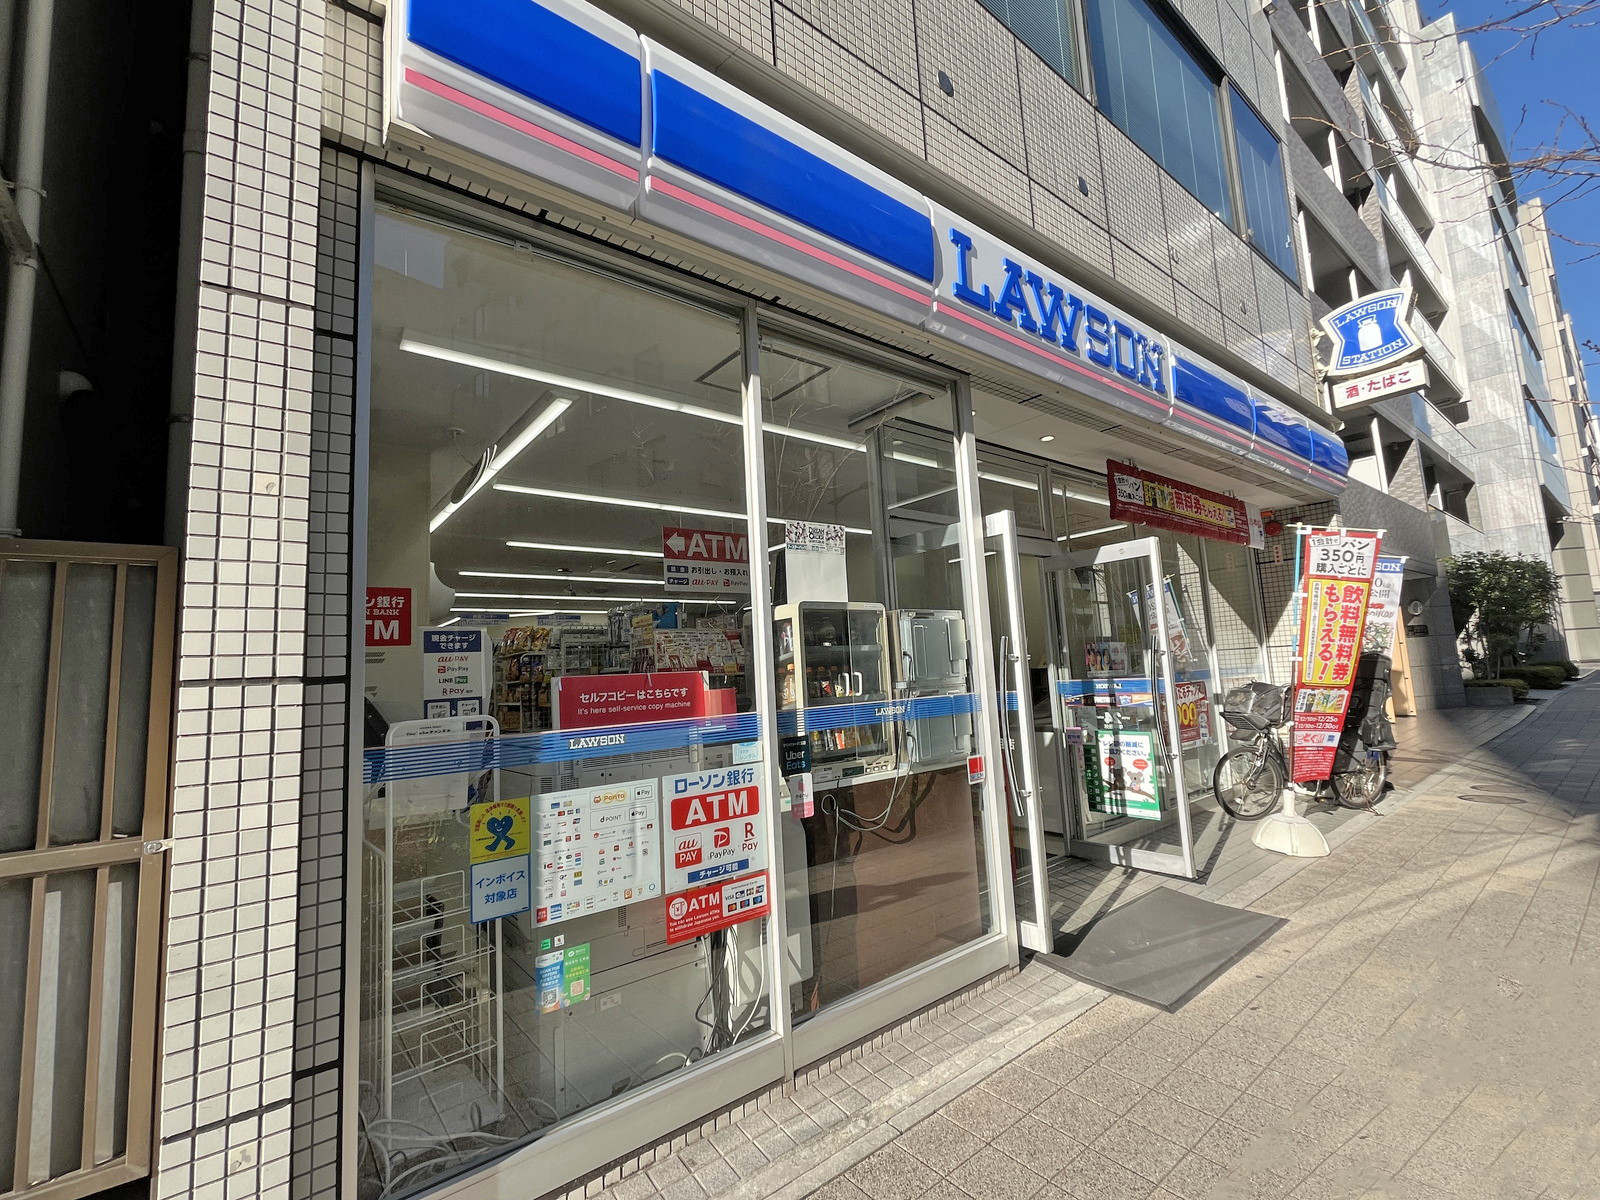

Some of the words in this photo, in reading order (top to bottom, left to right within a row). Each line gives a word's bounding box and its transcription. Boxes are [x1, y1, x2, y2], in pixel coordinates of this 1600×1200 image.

[949, 227, 1166, 394] LAWSON
[1335, 298, 1399, 328] LAWSON
[1341, 338, 1405, 366] STATION
[1345, 371, 1411, 399] 酒・たばこ
[687, 533, 748, 561] ATM
[1341, 539, 1369, 550] パン
[1320, 548, 1364, 563] 350円
[1316, 562, 1367, 576] 購入ごとに
[431, 633, 476, 643] 現金チャージ
[1332, 584, 1365, 681] 飲料無料券
[439, 642, 469, 650] できます
[579, 687, 689, 703] セルフコピーはこちらです
[577, 707, 589, 715] It's
[590, 706, 606, 714] here
[608, 704, 647, 713] self-service
[648, 702, 663, 711] copy
[664, 700, 691, 709] machine
[874, 705, 906, 716] LAWSON
[569, 733, 626, 749] LAWSON
[785, 750, 806, 760] Uber
[786, 760, 806, 770] Eats
[675, 768, 755, 794] ローソン銀行
[641, 788, 650, 797] Pay
[685, 790, 748, 826] ATM
[744, 822, 755, 841] R
[679, 838, 698, 850] au
[742, 841, 758, 851] Pay
[679, 850, 697, 864] PAY
[709, 848, 736, 860] PayPay
[699, 863, 739, 879] チャージ可能
[475, 870, 526, 889] インボイス
[484, 888, 518, 904] 対象店
[688, 891, 720, 912] ATM
[694, 912, 709, 920] Lawson
[674, 922, 693, 931] withdraw
[693, 917, 712, 926] Japanese
